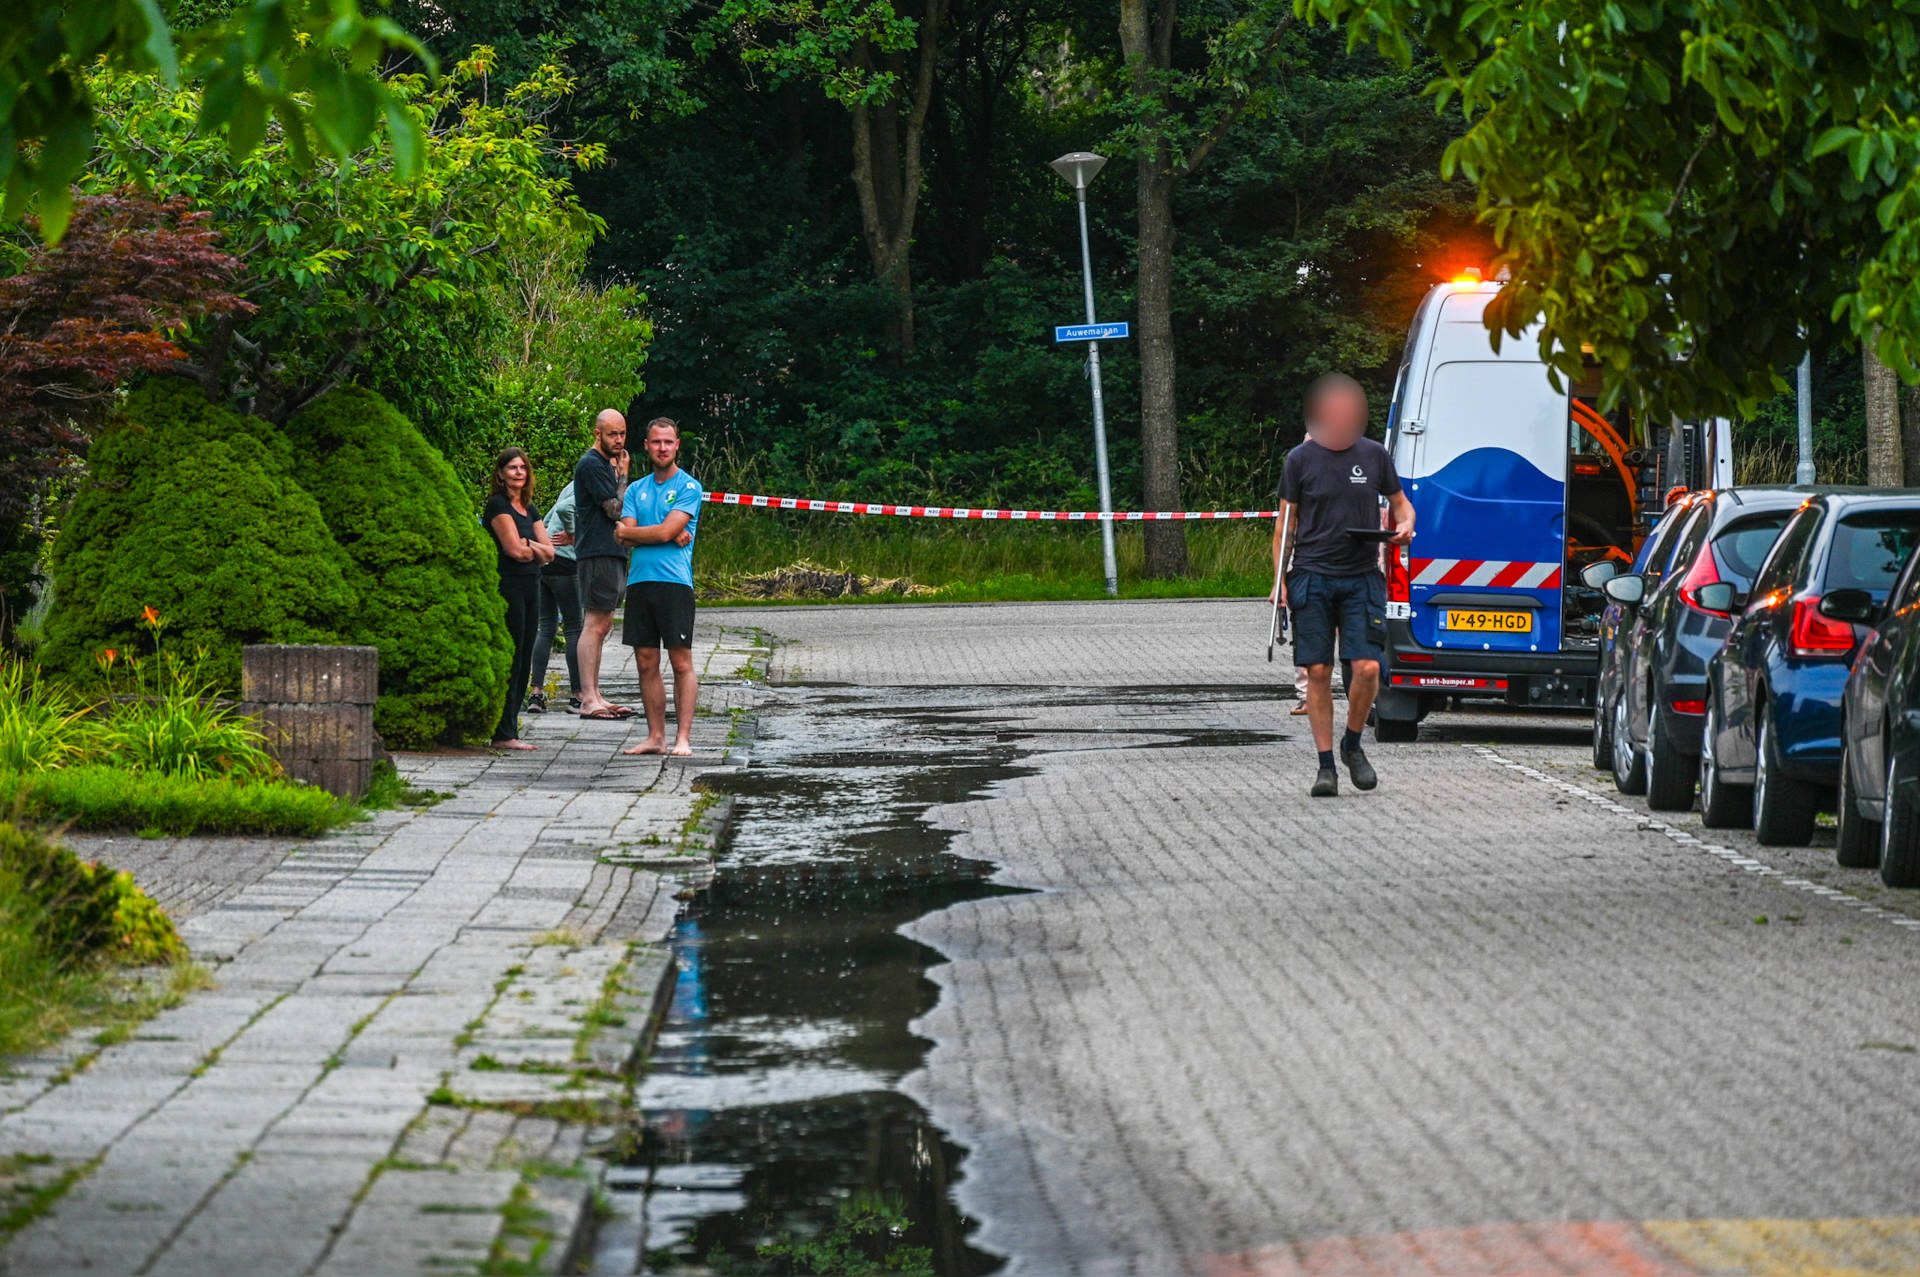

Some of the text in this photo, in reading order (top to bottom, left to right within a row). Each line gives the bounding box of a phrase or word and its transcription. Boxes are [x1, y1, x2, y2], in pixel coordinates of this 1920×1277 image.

[1066, 327, 1119, 337] Auwemalaan
[1450, 613, 1526, 629] V-49-HGD
[1426, 677, 1475, 686] safe-bumper.nl
